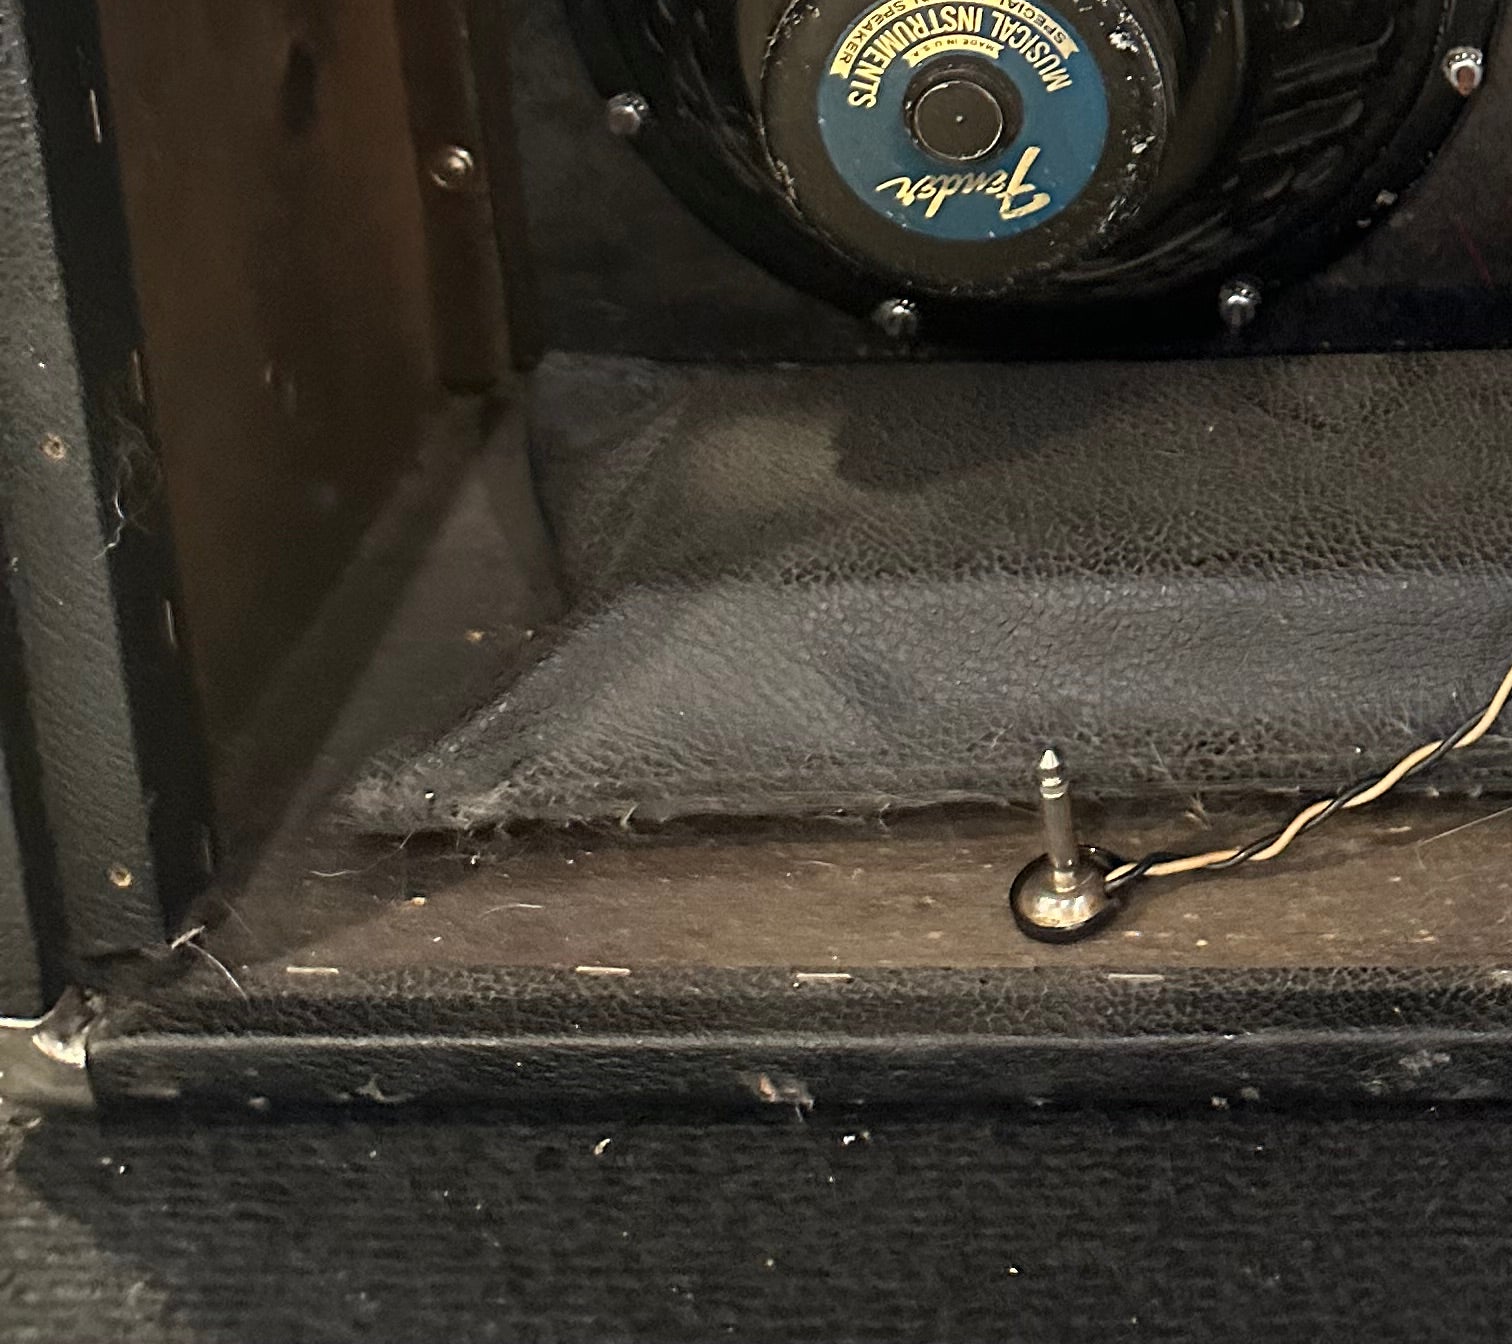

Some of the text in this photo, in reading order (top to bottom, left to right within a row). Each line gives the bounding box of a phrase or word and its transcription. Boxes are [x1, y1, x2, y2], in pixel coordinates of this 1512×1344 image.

[839, 0, 906, 64] SPEAKER
[847, 5, 1073, 109] MUSICAL INSTRUMENTS
[947, 38, 959, 46] IN
[966, 38, 995, 52] MADE
[875, 146, 1050, 220] Fender
